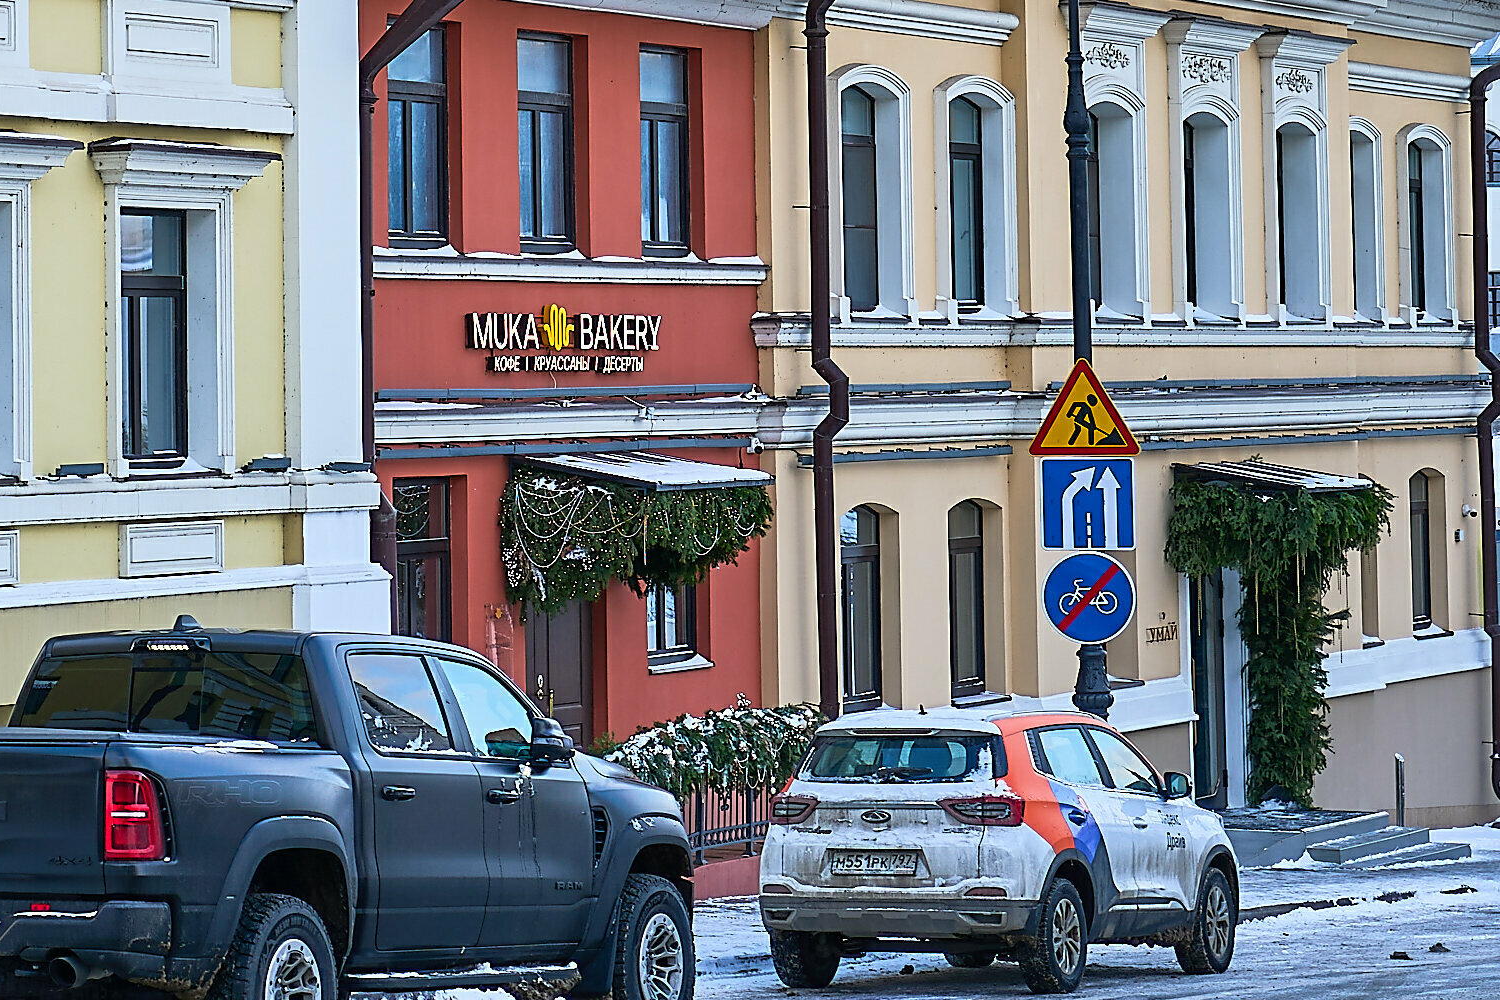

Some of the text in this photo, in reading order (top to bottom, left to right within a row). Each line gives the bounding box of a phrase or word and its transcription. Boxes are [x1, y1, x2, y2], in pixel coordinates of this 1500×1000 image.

[472, 312, 662, 351] MUKA BAKERY
[494, 355, 644, 373] КОФЕ КРУАССАНЫ ДЕСЕРТЫ
[891, 854, 912, 866] 797
[555, 880, 584, 890] RAM
